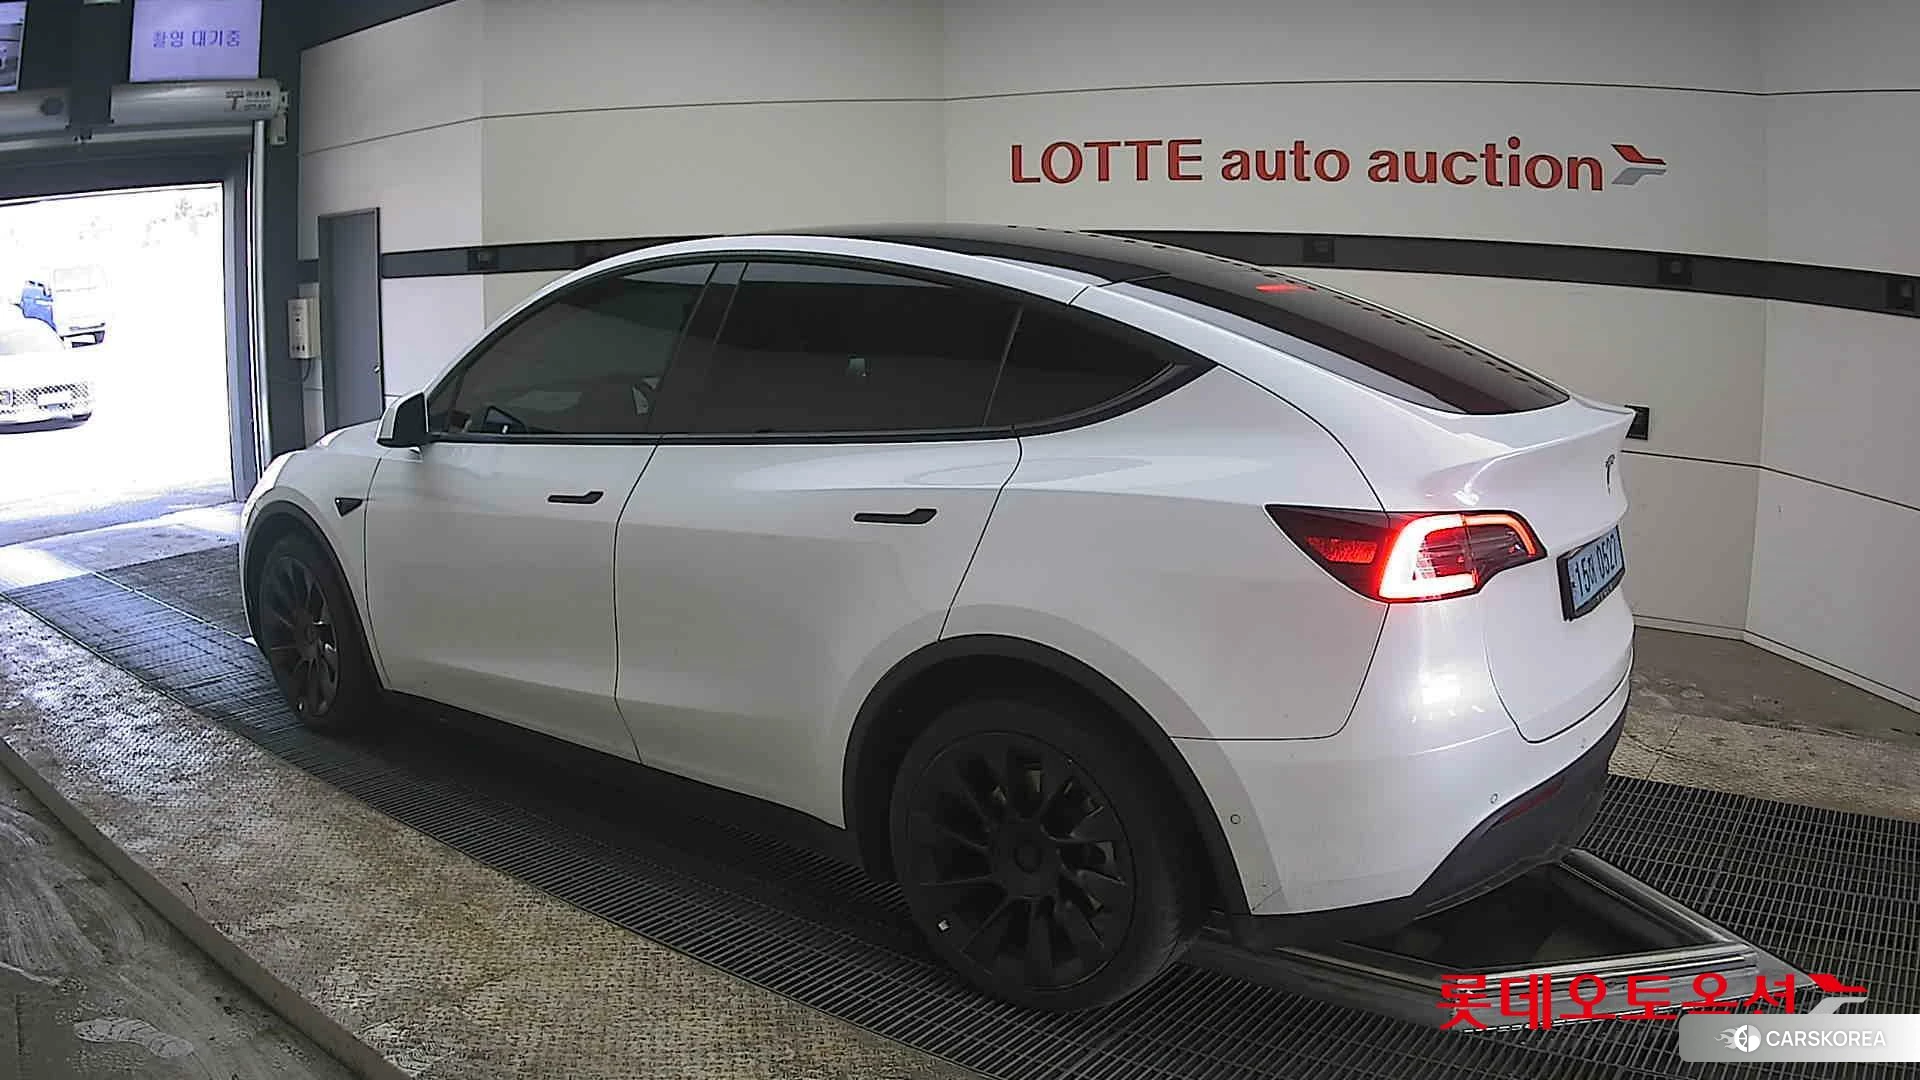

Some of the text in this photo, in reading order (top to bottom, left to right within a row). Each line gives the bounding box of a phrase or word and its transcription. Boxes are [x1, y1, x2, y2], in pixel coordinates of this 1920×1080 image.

[192, 30, 241, 48] 대기중
[1010, 136, 1604, 191] LOTTE auto auction
[1596, 533, 1619, 579] 0527
